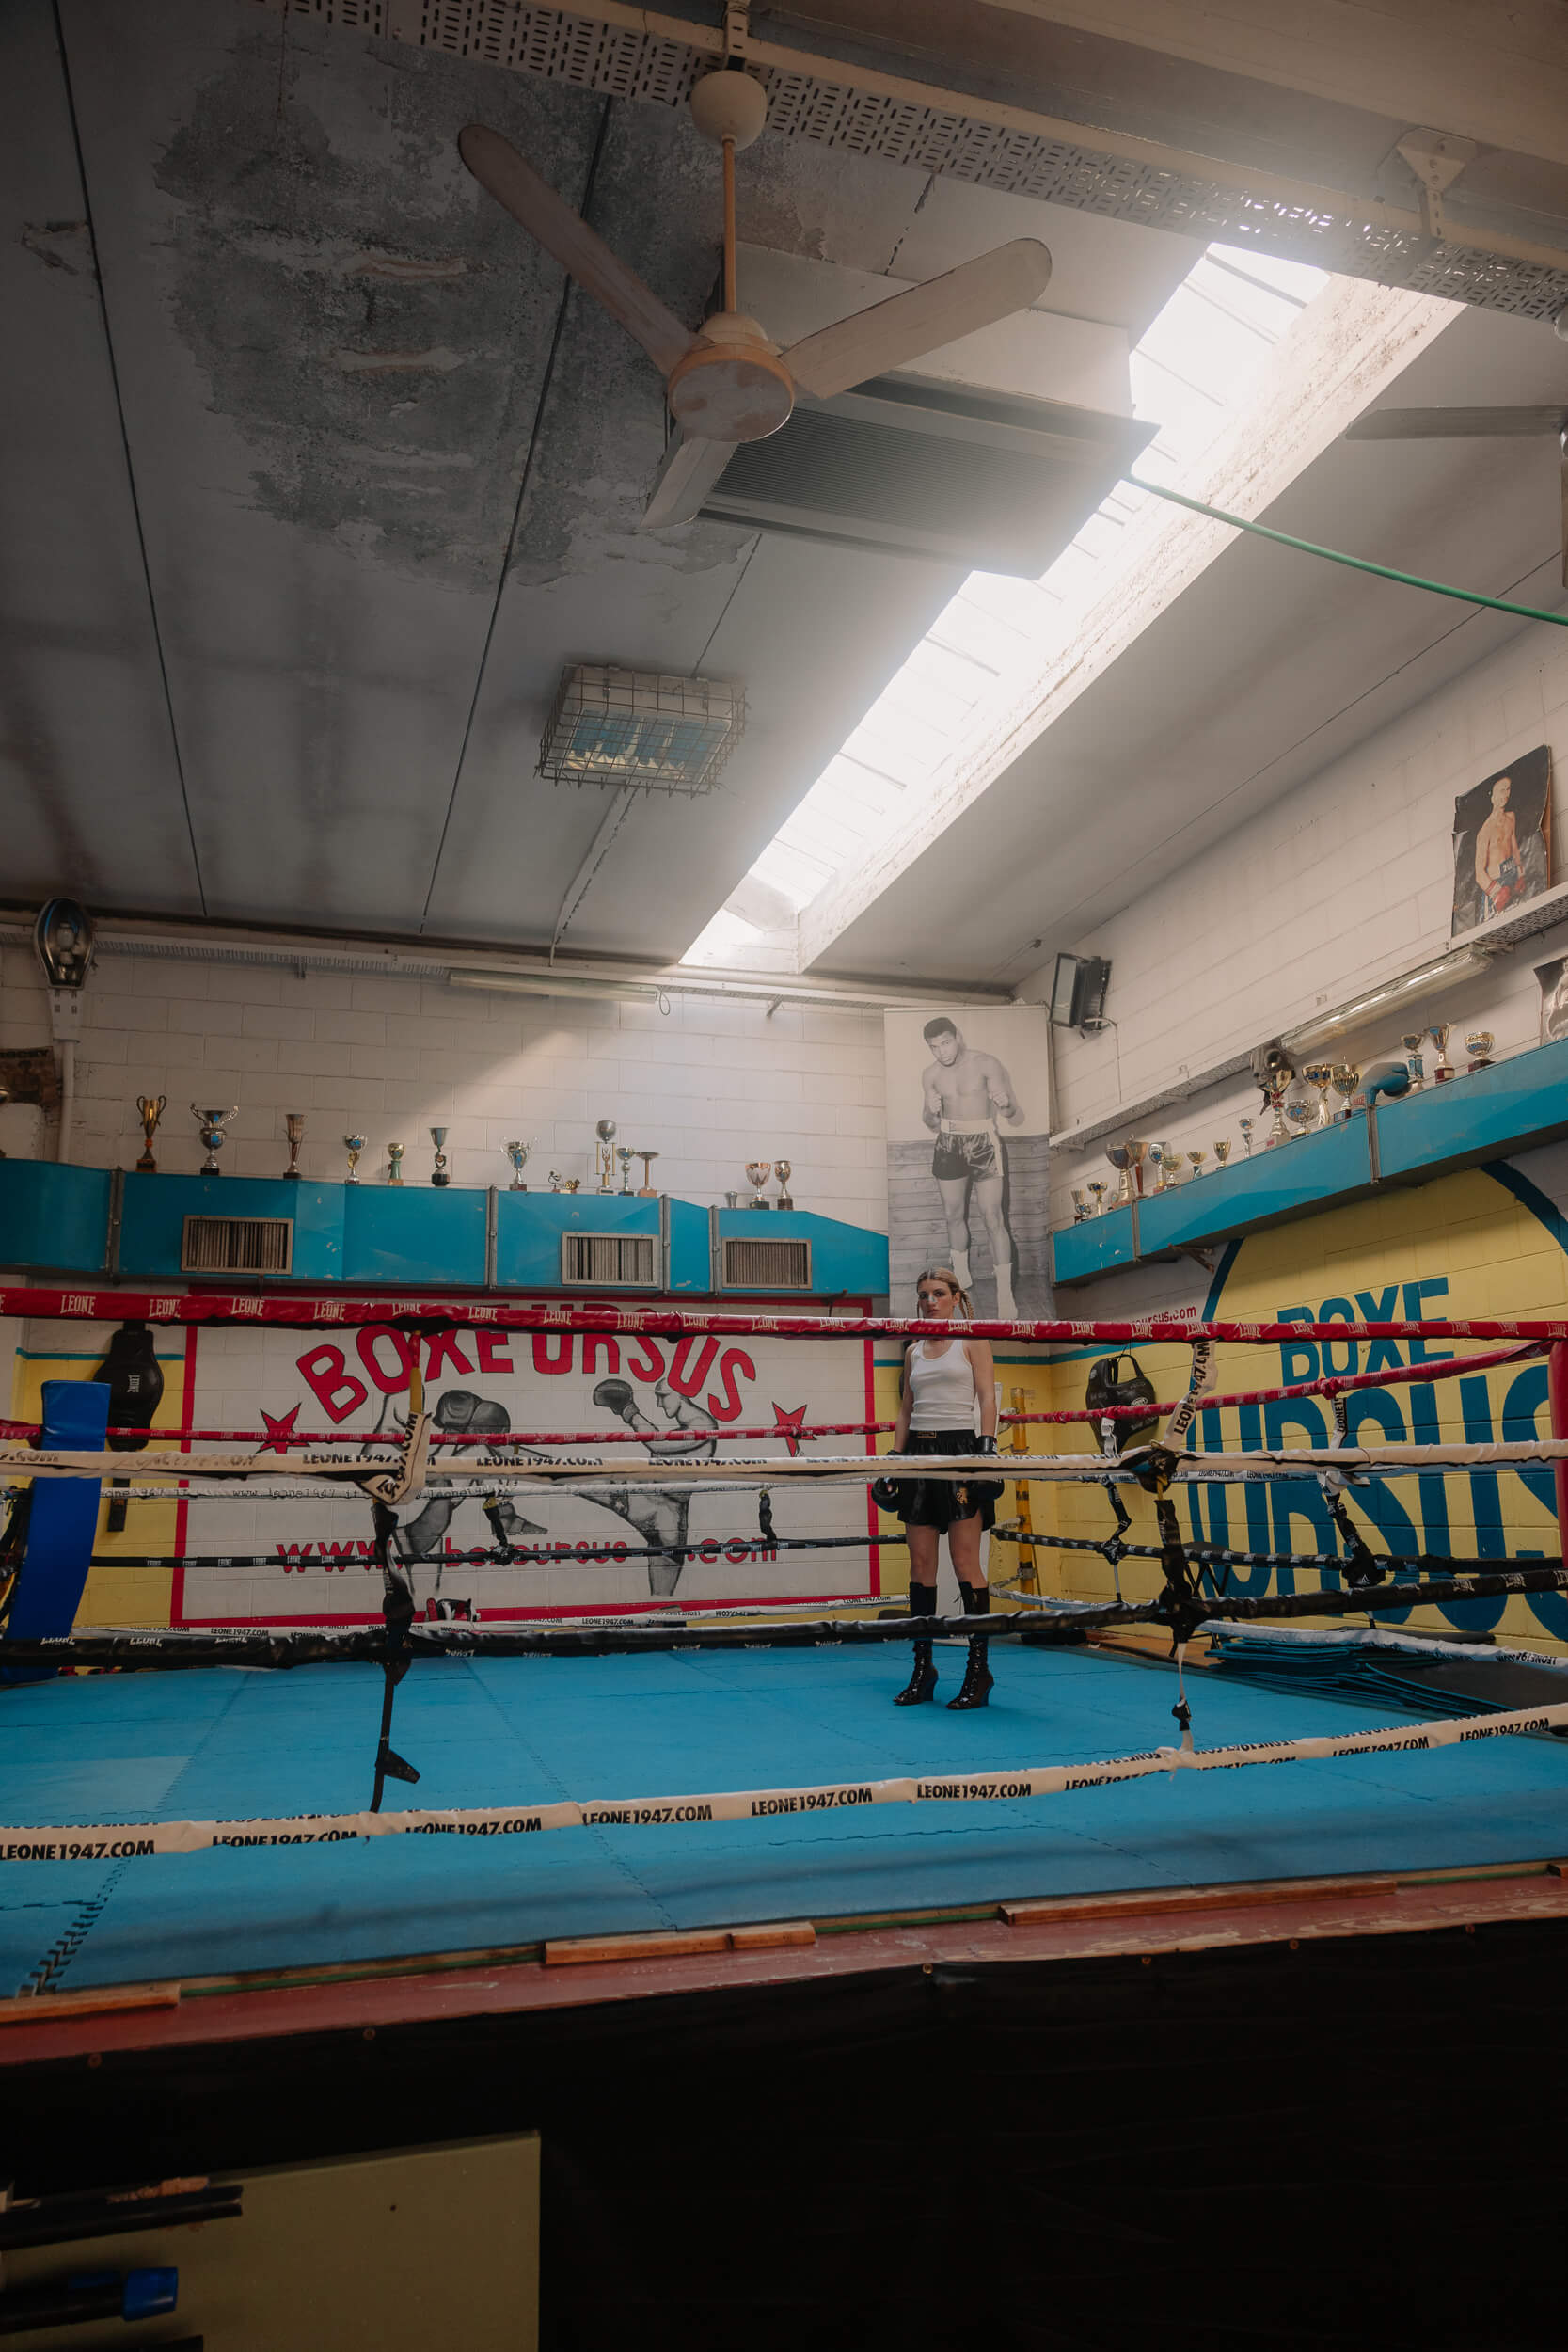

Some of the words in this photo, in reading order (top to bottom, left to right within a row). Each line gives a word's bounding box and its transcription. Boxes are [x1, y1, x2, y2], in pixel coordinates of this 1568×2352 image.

[59, 1295, 96, 1316] LEONE
[231, 1297, 266, 1317] LEONE
[312, 1302, 346, 1321] LEONE
[391, 1302, 422, 1316] LEONE
[467, 1307, 499, 1322] LEONE
[543, 1310, 573, 1325] LEONE
[616, 1312, 645, 1331] LEONE
[682, 1316, 710, 1329] LEONE
[752, 1317, 779, 1331] LEONE
[884, 1319, 910, 1332] LEONE
[946, 1321, 974, 1333] LEONE
[1011, 1323, 1037, 1337] LEONE
[1070, 1322, 1096, 1337] LEONE
[1130, 1323, 1154, 1339] LEONE
[1185, 1322, 1212, 1336] LEONE
[1238, 1325, 1262, 1339] LEONE
[1291, 1323, 1316, 1336] LEONE
[1345, 1323, 1370, 1336] LEONE
[1451, 1323, 1473, 1335] LEONE
[296, 1303, 515, 1424] BOXE
[531, 1303, 756, 1422] URSUS
[1277, 1277, 1454, 1386] BOXE
[0, 1840, 155, 1860] LEONE1947.COM
[212, 1830, 357, 1847] LEONE1947COM
[583, 1804, 713, 1825] LEONE1947.COM
[752, 1788, 873, 1816] LEONE1947.COM
[917, 1783, 1031, 1799] LEONE1947.COM
